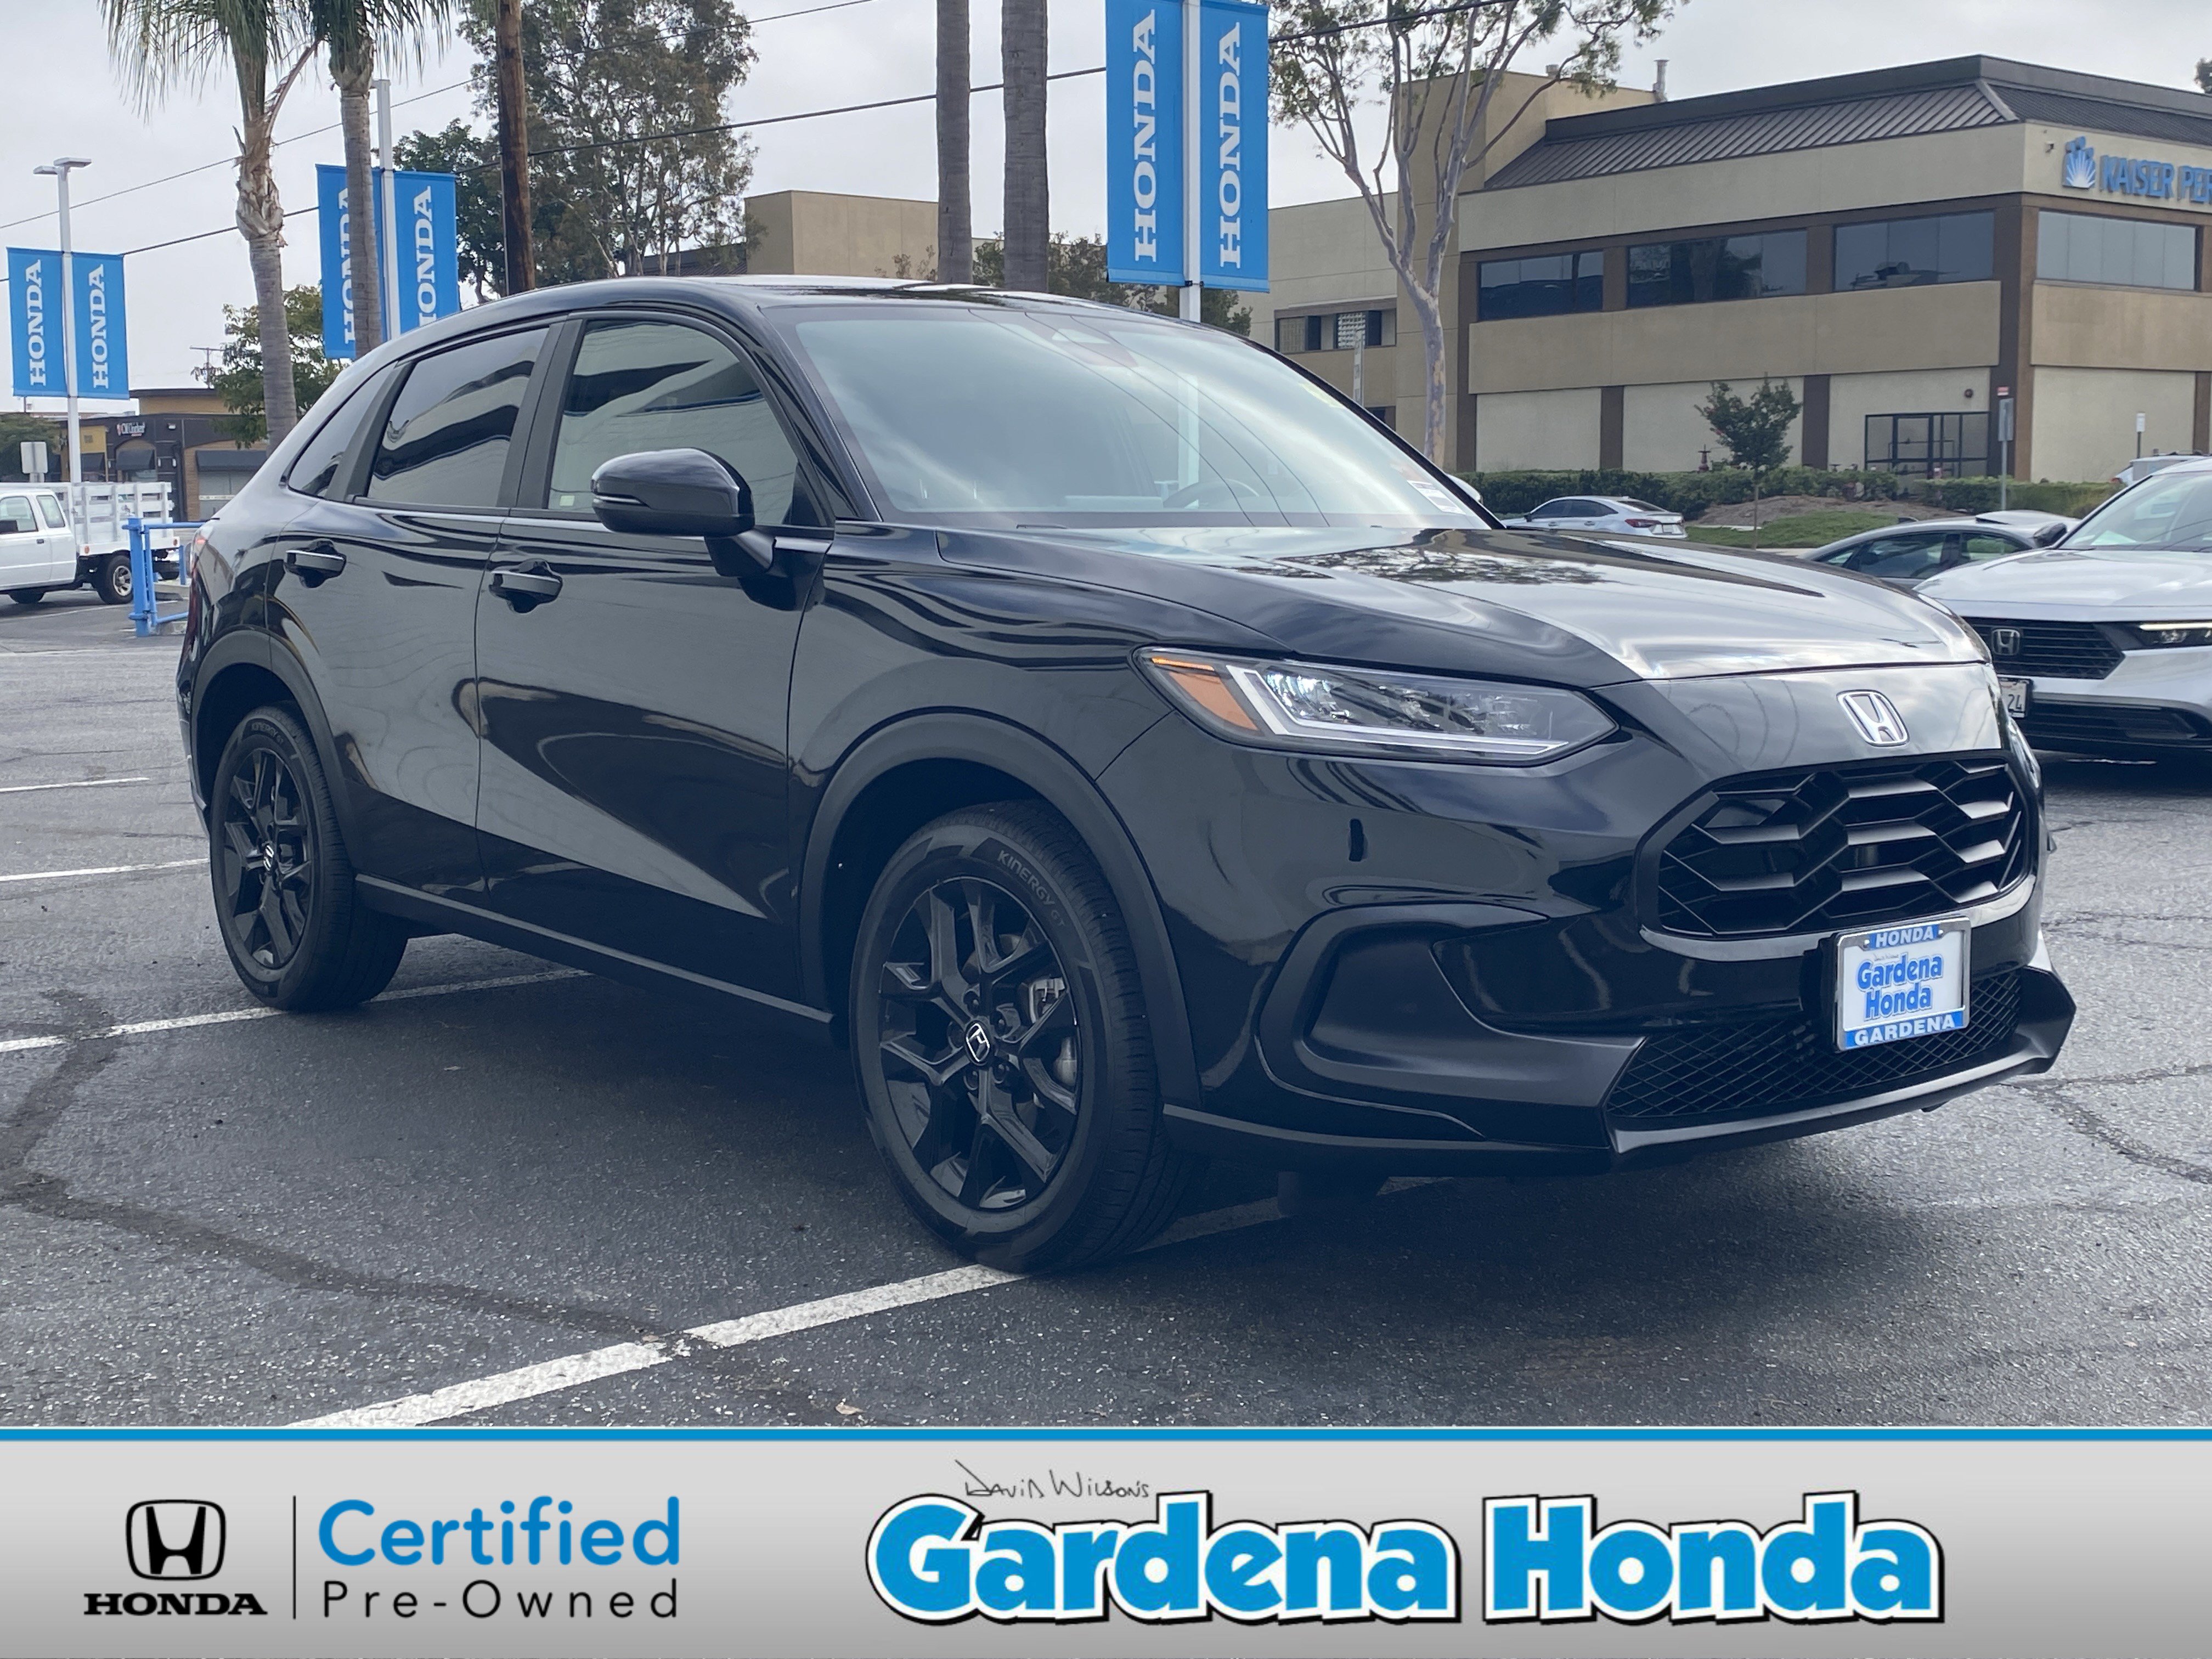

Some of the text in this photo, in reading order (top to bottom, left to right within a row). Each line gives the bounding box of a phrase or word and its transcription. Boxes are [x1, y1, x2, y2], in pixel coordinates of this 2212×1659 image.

[1132, 9, 1156, 263] HONDA
[1218, 22, 1242, 269] HONDA
[2100, 154, 2175, 200] KAISER
[25, 259, 46, 386] HONDA
[88, 263, 109, 389] HONDA
[1875, 926, 1934, 949] HONDA
[1857, 952, 1944, 991] Gardena
[1864, 983, 1932, 1021] Honda
[1854, 1015, 1956, 1046] GARDENA
